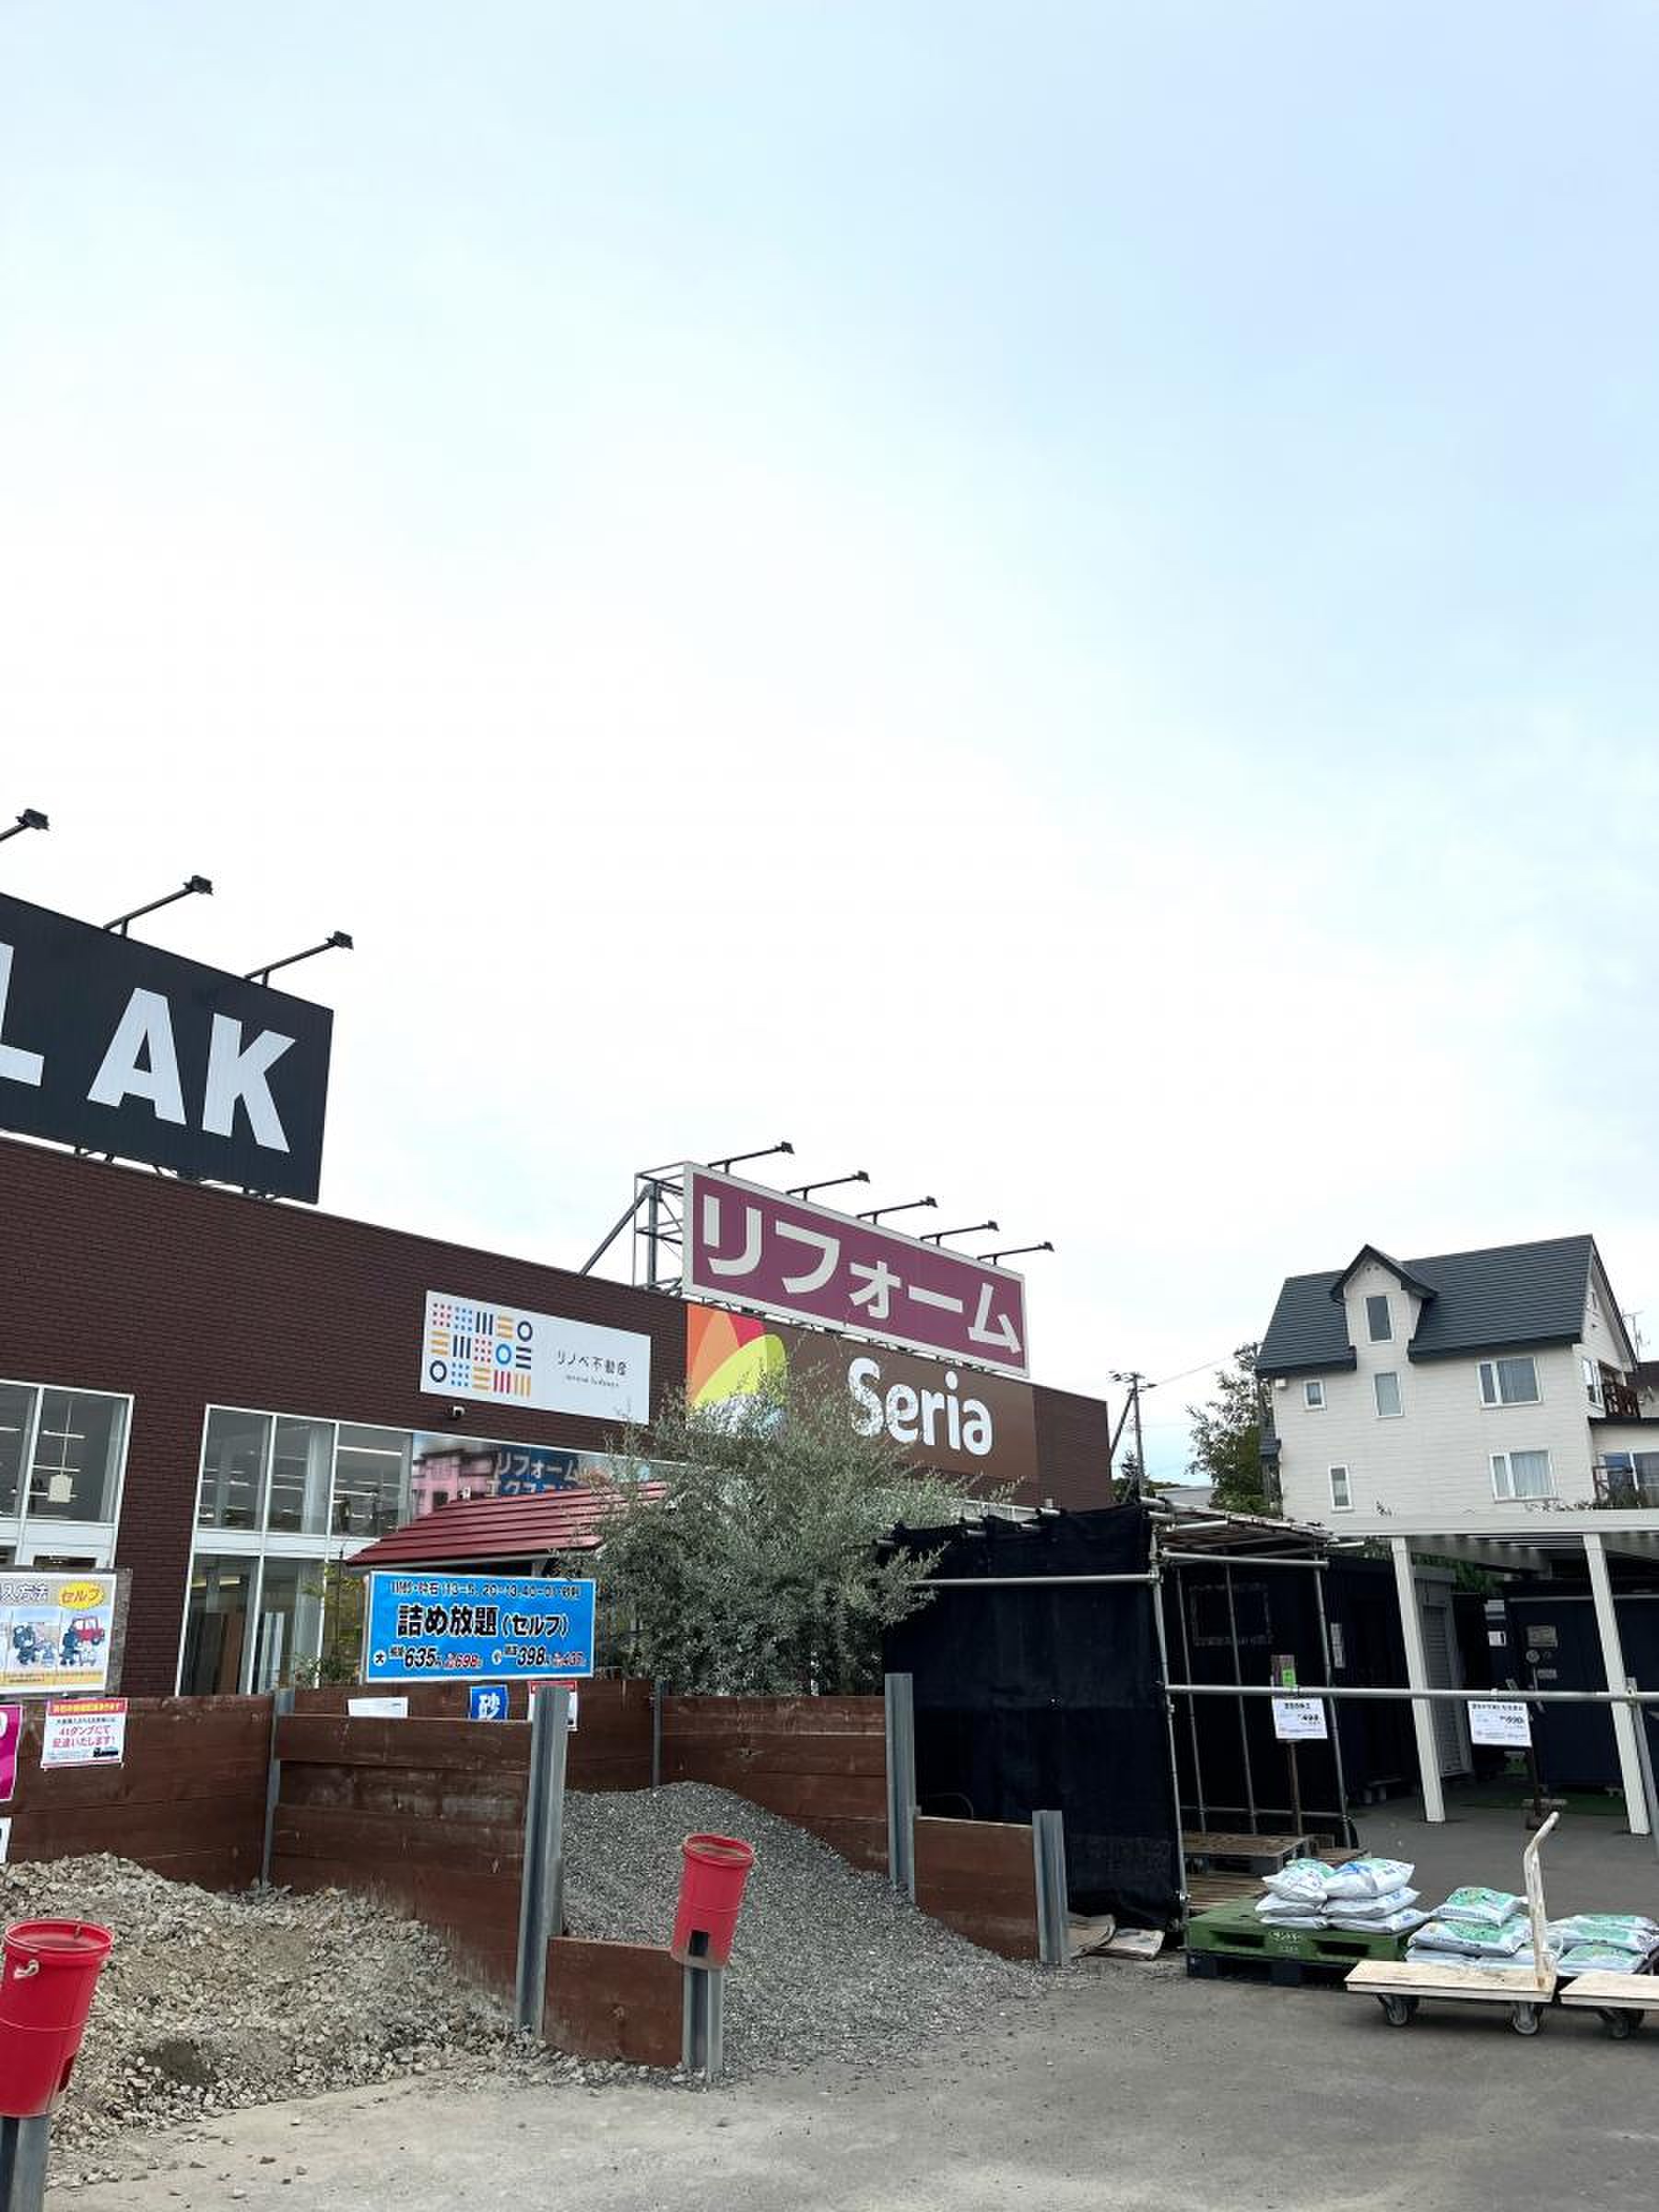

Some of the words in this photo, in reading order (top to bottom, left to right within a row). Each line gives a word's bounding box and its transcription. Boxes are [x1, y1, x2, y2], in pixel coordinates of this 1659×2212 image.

[87, 987, 296, 1153] AK
[703, 1194, 1022, 1354] リフォーム
[847, 1357, 993, 1456] Seria
[494, 1451, 579, 1482] リフォーム
[478, 1692, 500, 1720] 砂
